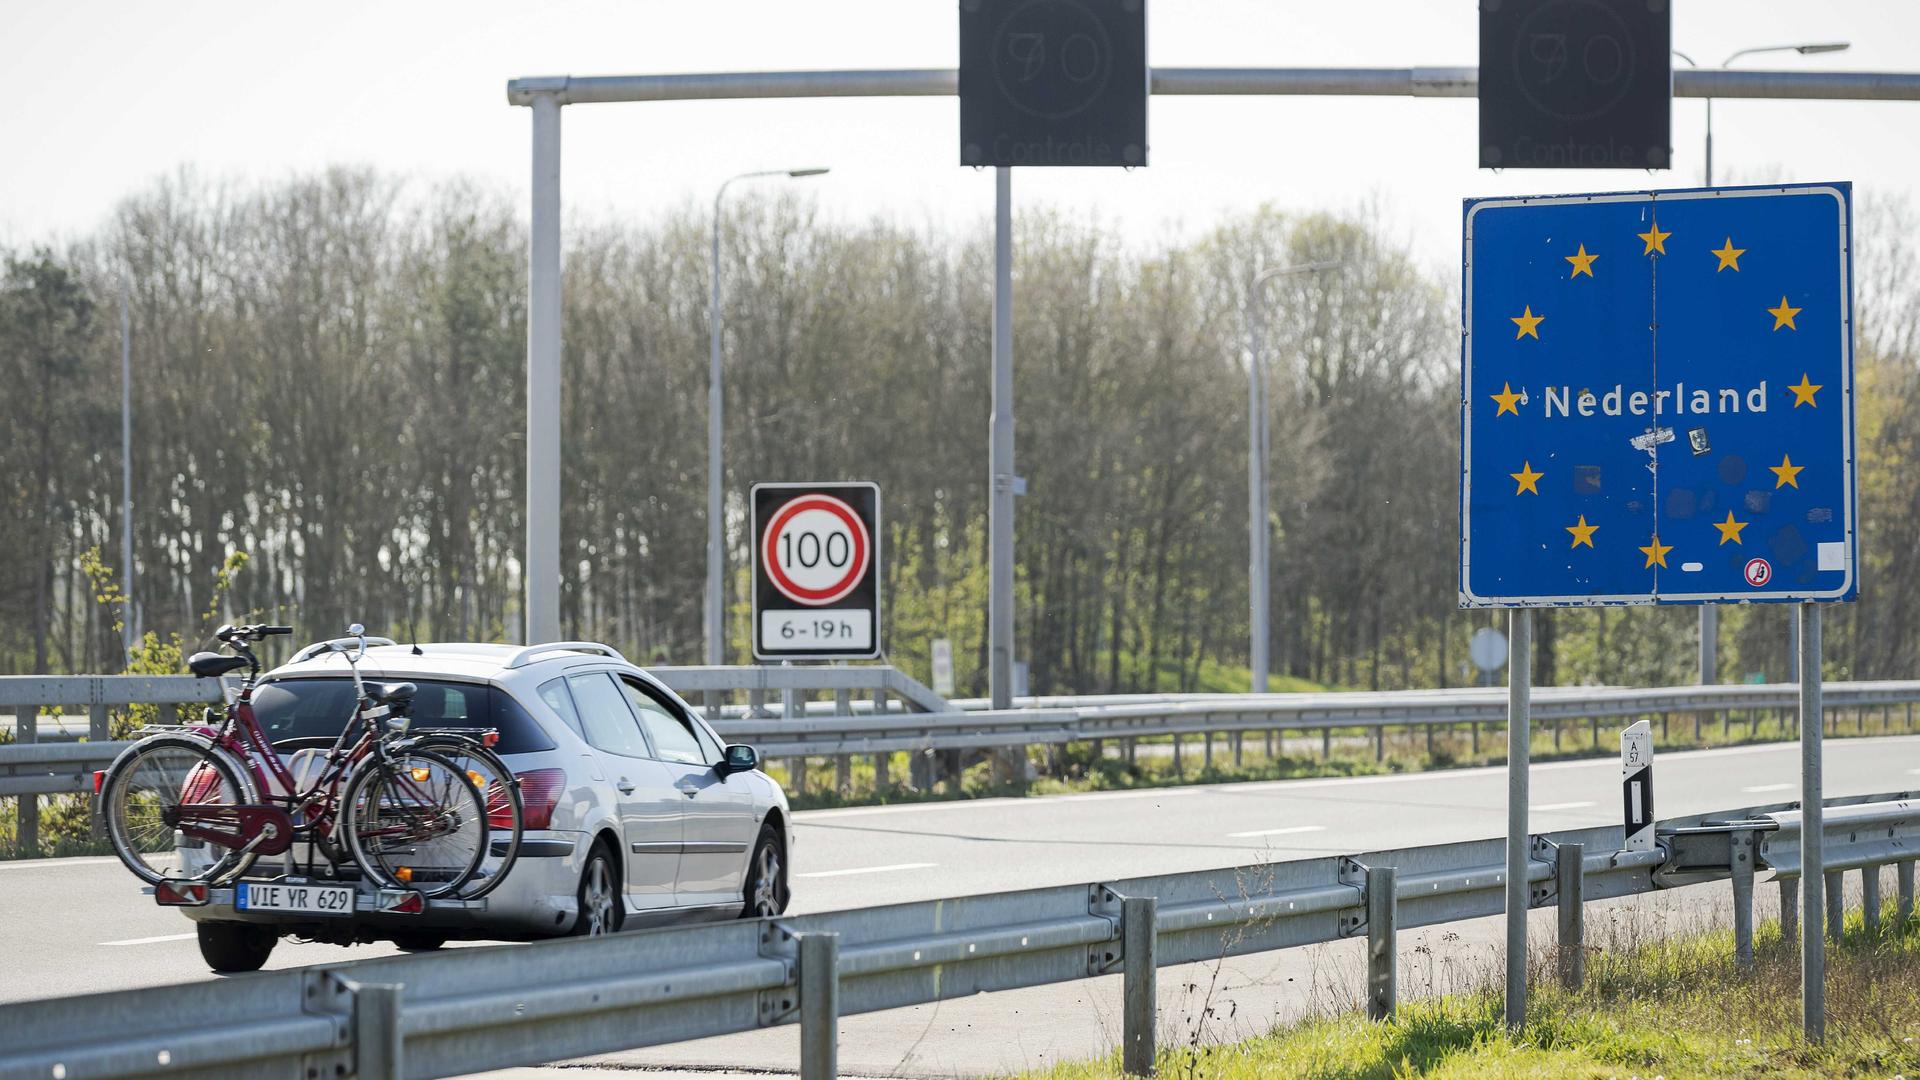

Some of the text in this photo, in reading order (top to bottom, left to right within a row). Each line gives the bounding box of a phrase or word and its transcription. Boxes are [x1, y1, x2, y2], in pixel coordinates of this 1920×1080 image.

[993, 133, 1112, 163] Controle
[1514, 135, 1634, 165] Controle
[1545, 380, 1768, 418] Nederland
[782, 531, 849, 568] 100
[1629, 752, 1639, 763] 57
[1631, 741, 1638, 751] A
[250, 886, 348, 910] VIE YR 629
